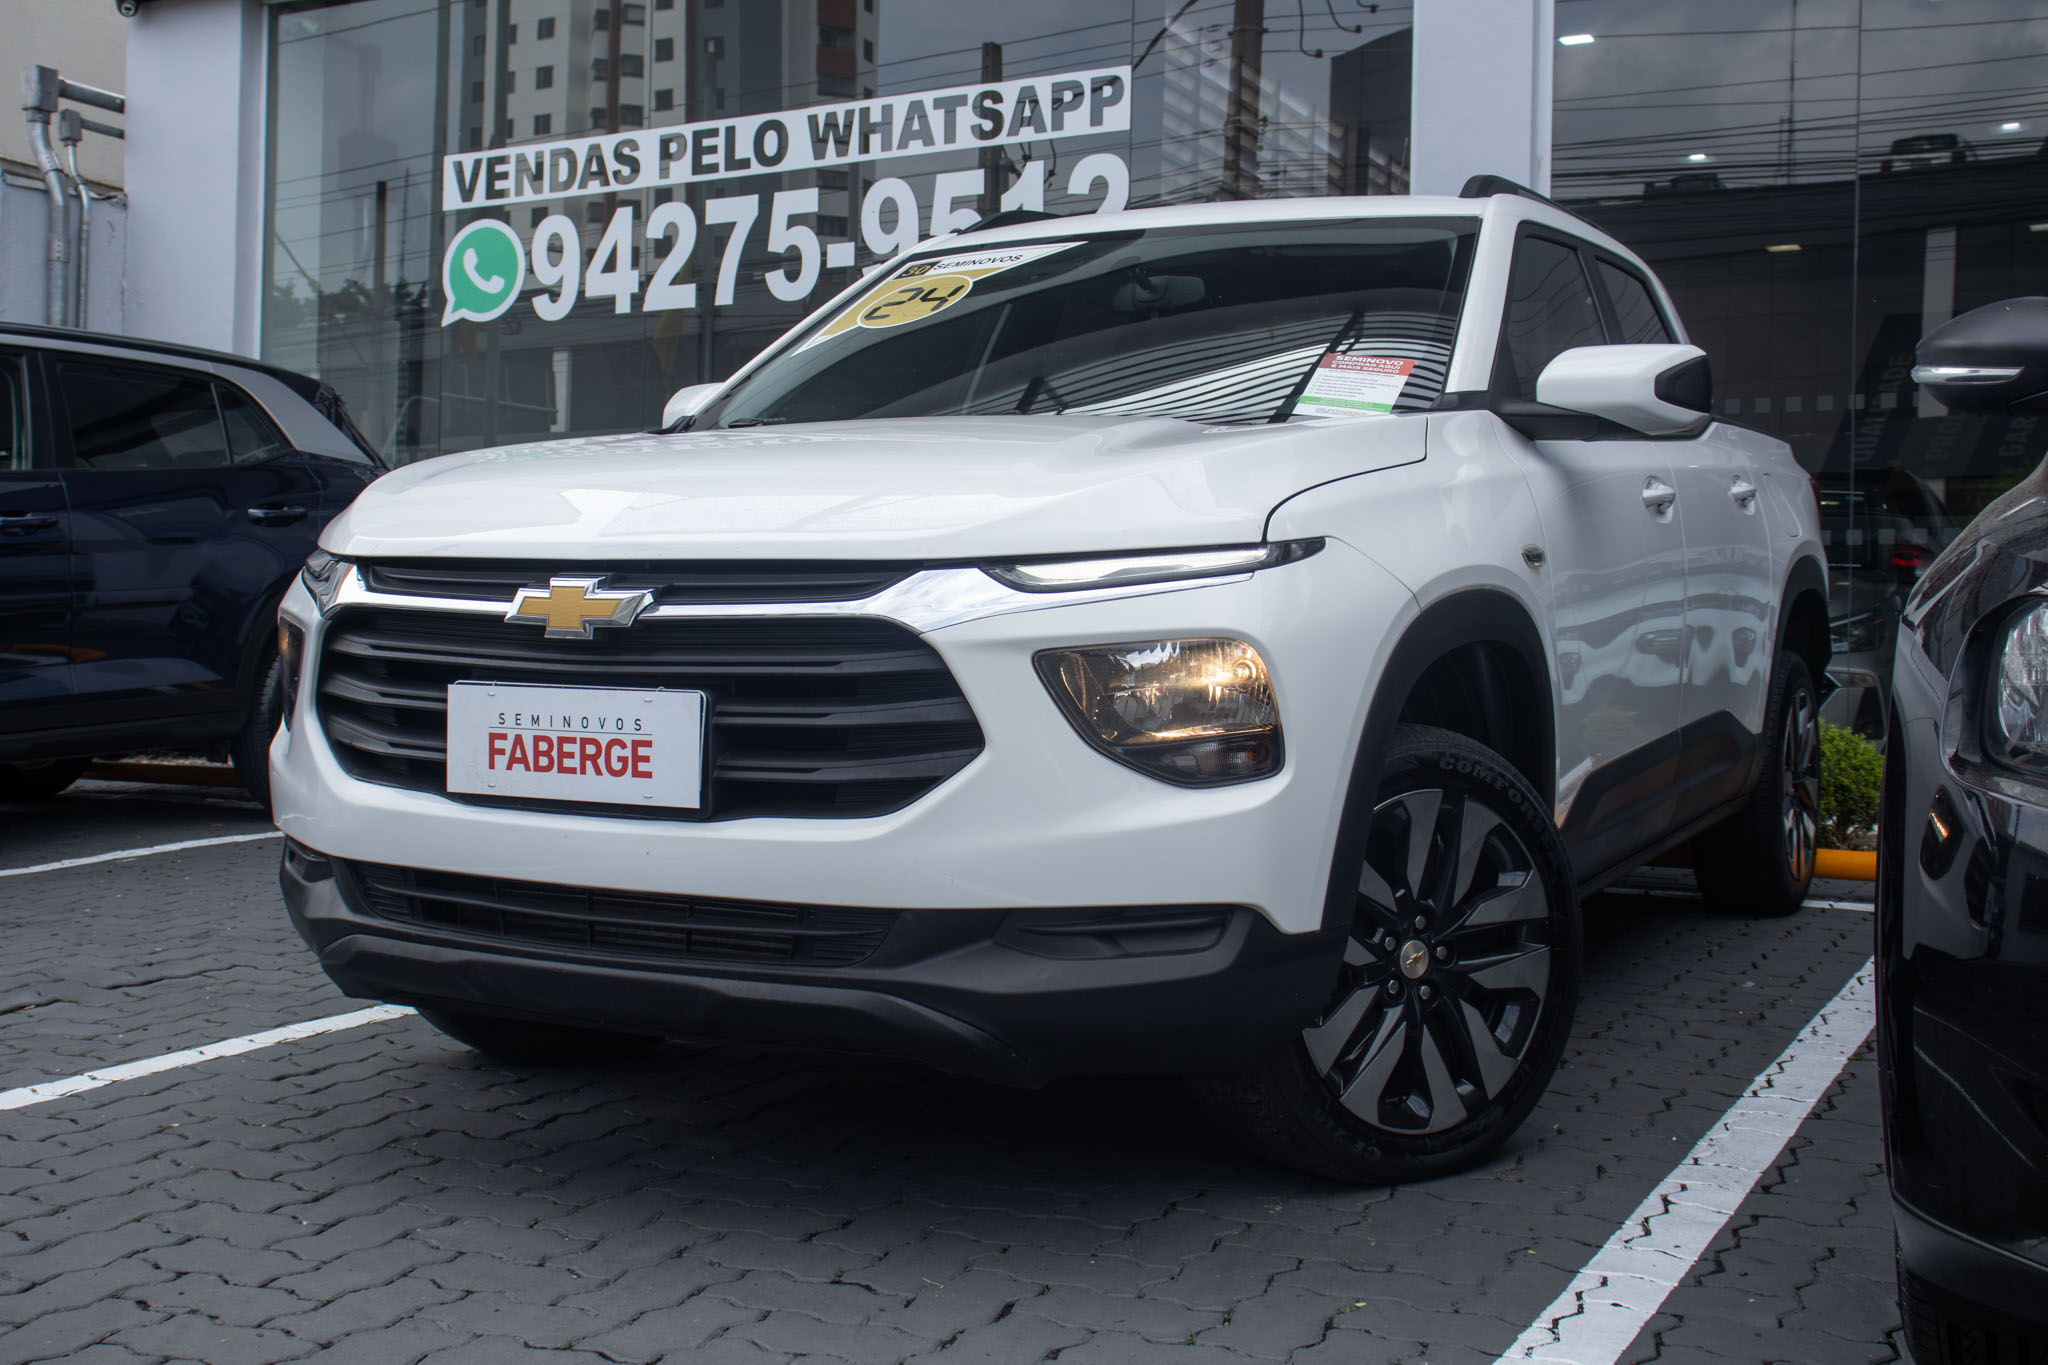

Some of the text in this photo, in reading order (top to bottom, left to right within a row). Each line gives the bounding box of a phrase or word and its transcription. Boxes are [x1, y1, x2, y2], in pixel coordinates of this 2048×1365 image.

[452, 75, 1125, 203] VENDAS PELO WHATSAPP
[531, 154, 1131, 322] 94275-9512
[933, 253, 1024, 271] SEMINOVOS
[863, 284, 966, 321] 24
[1335, 355, 1404, 366] SEMINOVO
[1362, 366, 1400, 374] SEGURO
[498, 712, 643, 732] SEMINOVOS
[488, 732, 653, 779] FABERGE
